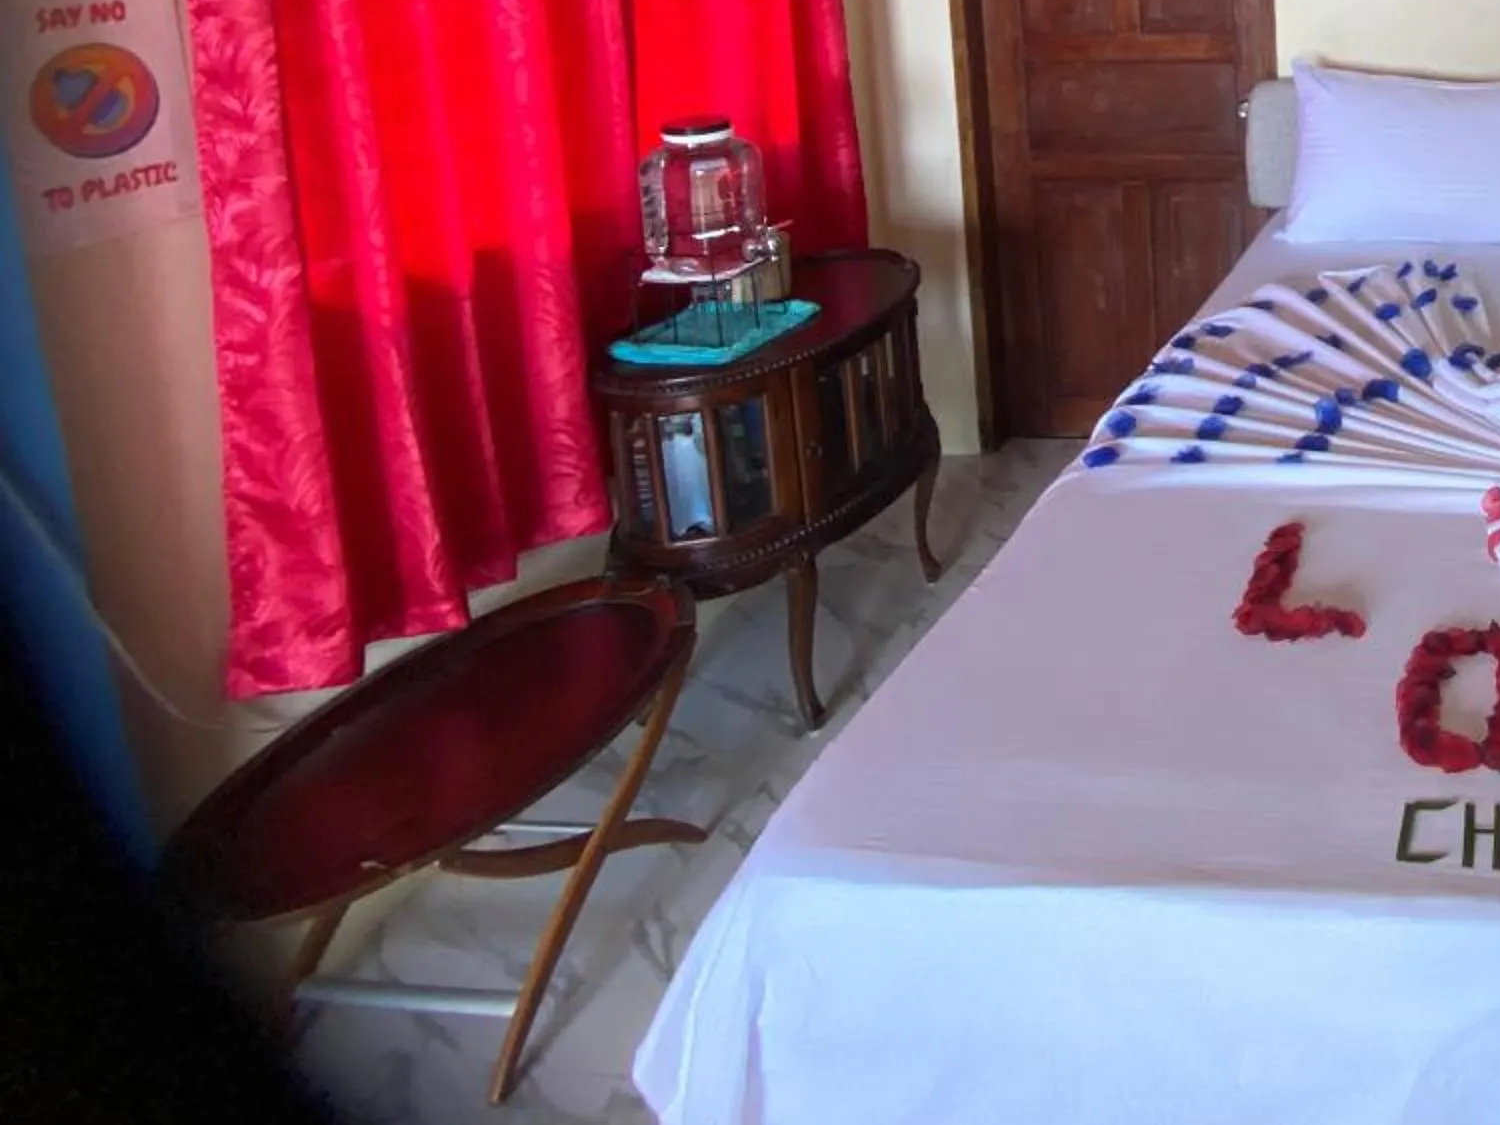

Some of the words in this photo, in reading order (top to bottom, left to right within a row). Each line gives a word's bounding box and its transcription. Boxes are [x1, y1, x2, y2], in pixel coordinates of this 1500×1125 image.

[36, 5, 82, 33] SAY
[90, 0, 126, 22] NO
[42, 187, 74, 210] TO
[81, 161, 178, 203] PLASTIC
